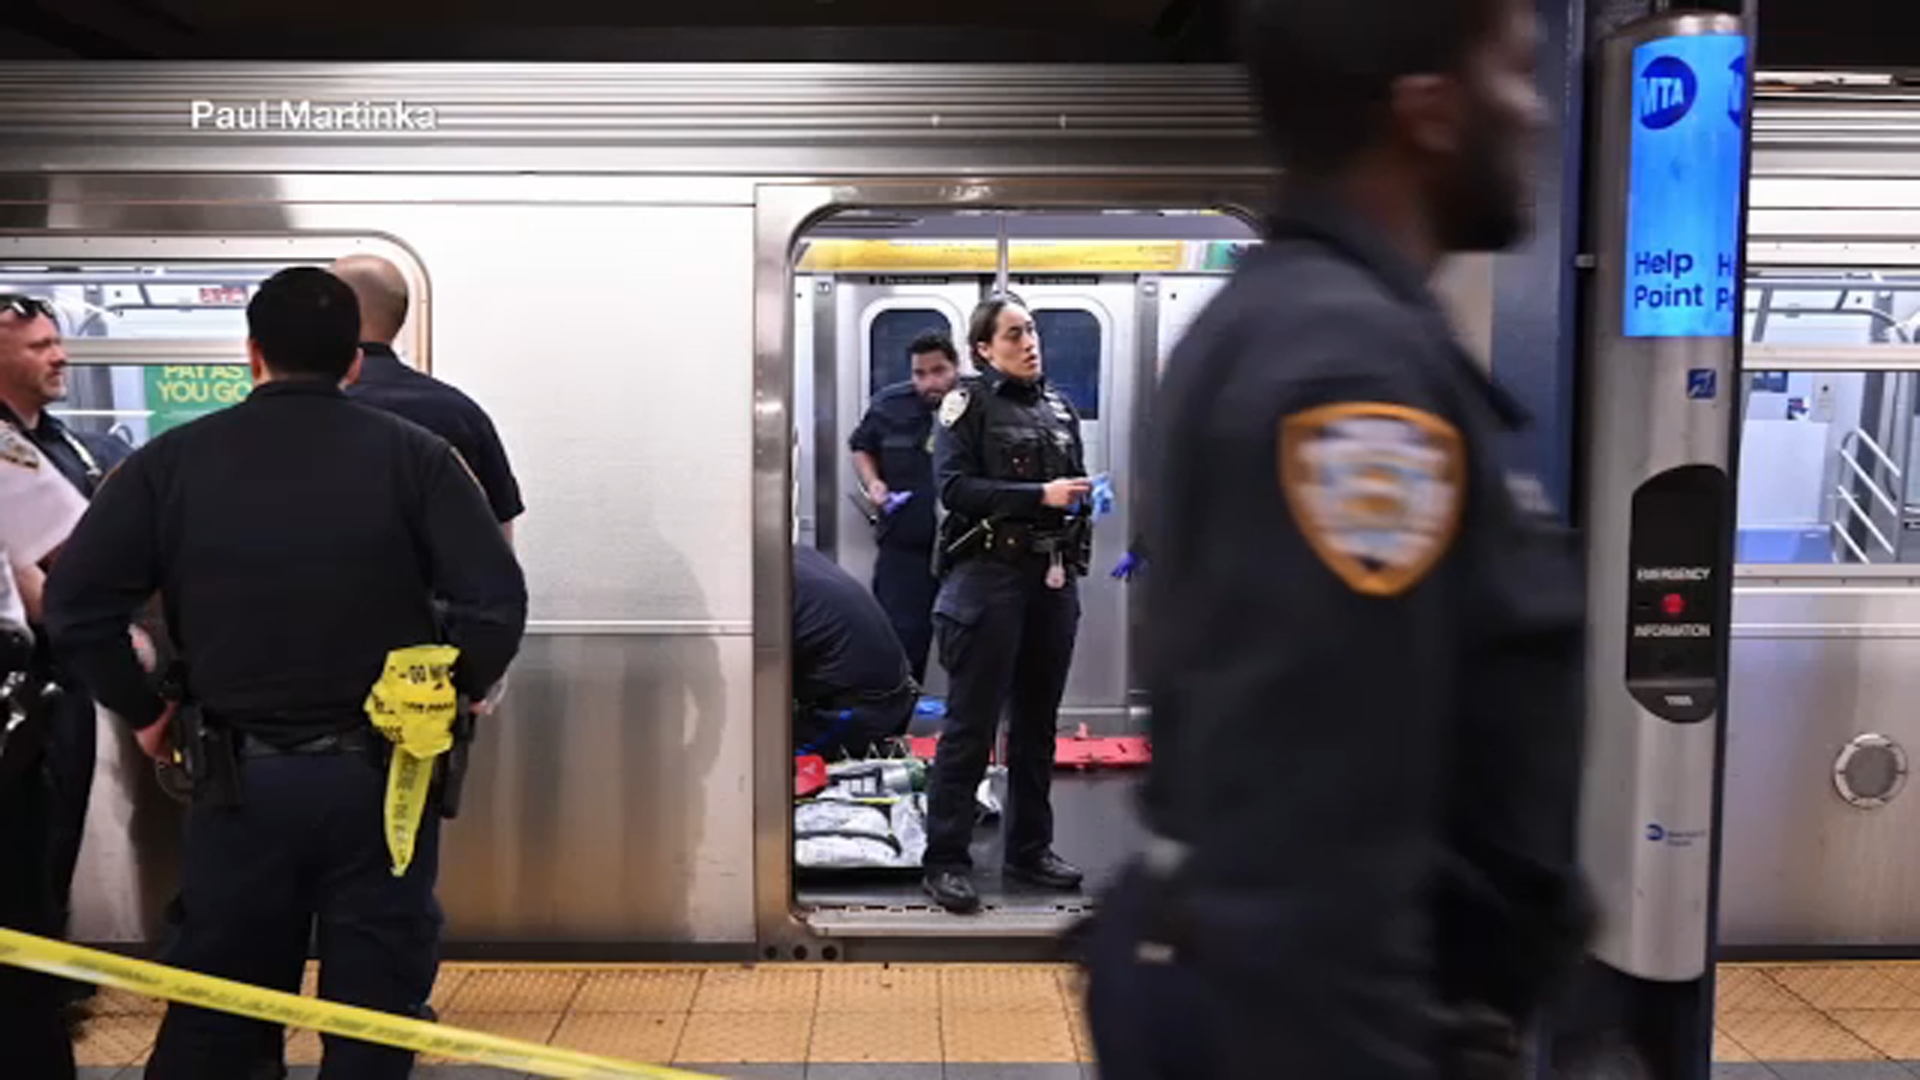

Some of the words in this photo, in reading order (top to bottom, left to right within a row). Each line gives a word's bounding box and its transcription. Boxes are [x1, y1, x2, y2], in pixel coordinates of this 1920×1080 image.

[1634, 248, 1694, 280] Help
[1634, 282, 1705, 310] Point
[163, 365, 207, 380] PAY
[209, 365, 245, 380] AS
[155, 380, 210, 403] YOU
[211, 380, 252, 403] GO
[1634, 623, 1712, 638] INFORMATION
